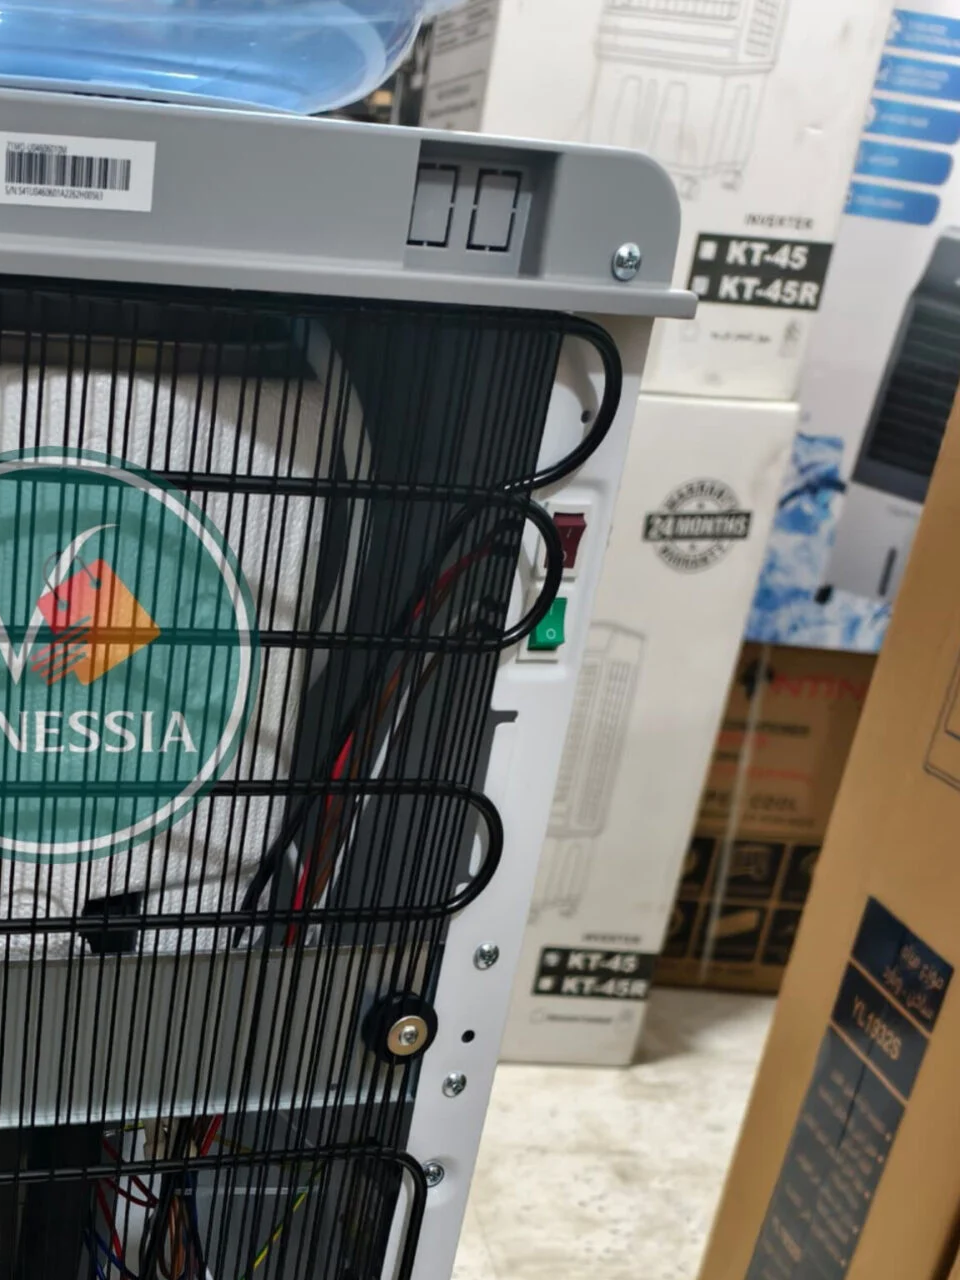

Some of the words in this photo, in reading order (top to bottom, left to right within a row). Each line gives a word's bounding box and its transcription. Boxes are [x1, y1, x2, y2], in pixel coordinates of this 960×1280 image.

[745, 212, 814, 230] INVERTER
[726, 240, 808, 271] KT-45
[719, 275, 819, 307] KT-45R
[648, 515, 673, 540] 24
[675, 515, 747, 537] MONTHS
[567, 952, 638, 973] KT-45
[561, 975, 648, 997] KT-45R
